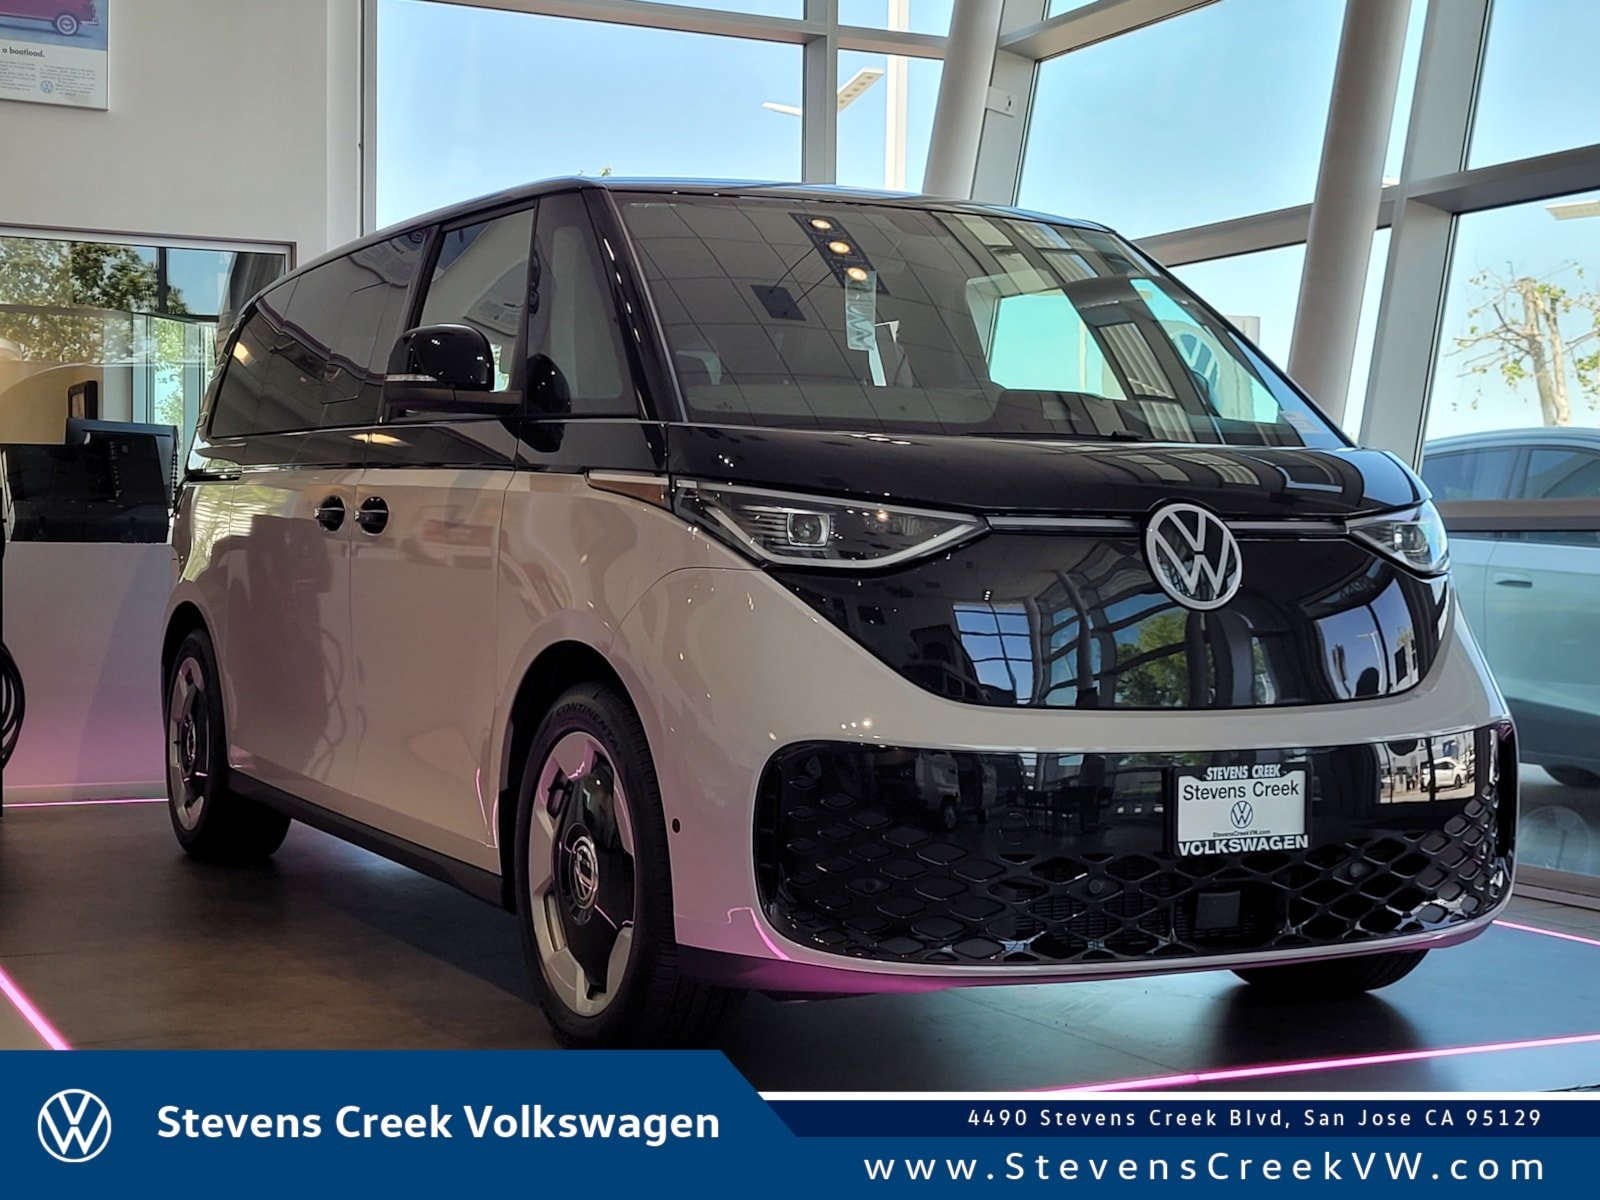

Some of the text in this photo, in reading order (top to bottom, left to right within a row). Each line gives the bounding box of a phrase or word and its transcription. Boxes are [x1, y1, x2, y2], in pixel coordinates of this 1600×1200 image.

[9, 46, 45, 57] boatload.
[1146, 503, 1242, 610] VW
[1206, 764, 1281, 780] STEVENS CREEK
[1183, 780, 1299, 801] Stevens Creek
[1230, 800, 1253, 828] VW
[1178, 835, 1309, 857] VOLKSWAGEN
